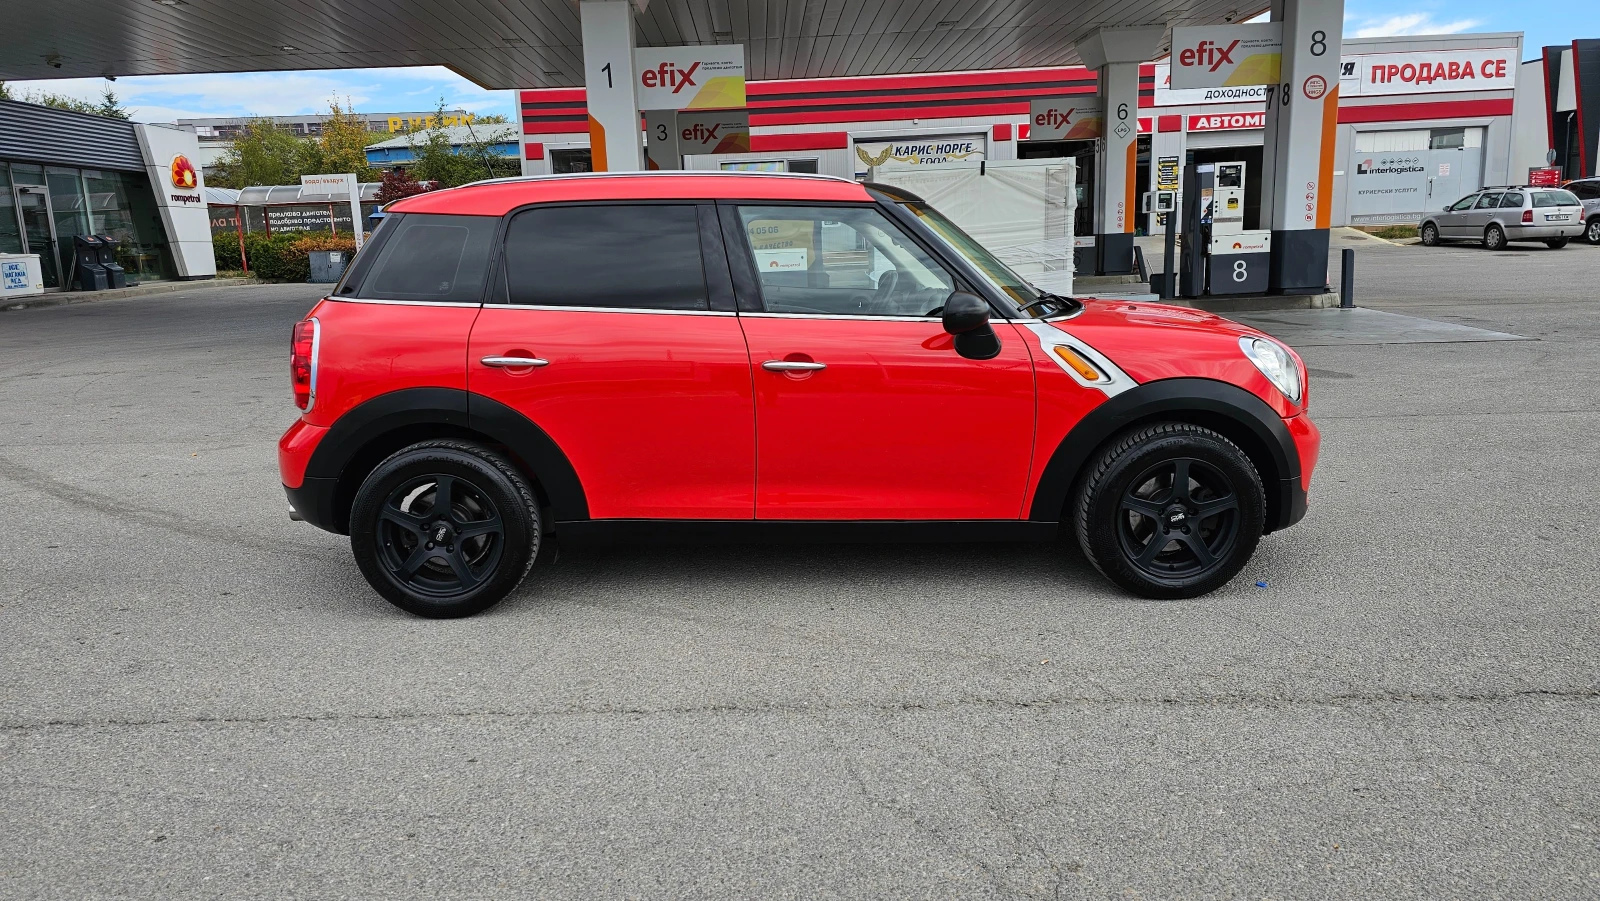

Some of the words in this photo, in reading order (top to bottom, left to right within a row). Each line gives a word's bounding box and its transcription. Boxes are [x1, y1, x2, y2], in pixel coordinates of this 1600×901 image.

[1310, 30, 1327, 57] 8
[1180, 39, 1240, 72] efix
[601, 62, 613, 89] 1
[641, 61, 702, 94] efix
[1371, 61, 1475, 85] ПРОДАВА
[1480, 59, 1507, 79] СЕ
[1267, 87, 1275, 110] 7
[1282, 82, 1290, 107] 8
[1035, 107, 1075, 130] efix
[1117, 103, 1128, 121] 6
[656, 124, 668, 142] 3
[682, 123, 721, 145] efix
[895, 144, 932, 157] КАРИС
[936, 142, 973, 155] НОРГЕ
[1095, 139, 1100, 154] 5
[1369, 165, 1424, 175] interlogistica
[171, 193, 201, 206] rompetrol
[1353, 212, 1421, 222] www.interlogistica.bg
[1232, 260, 1248, 283] 8
